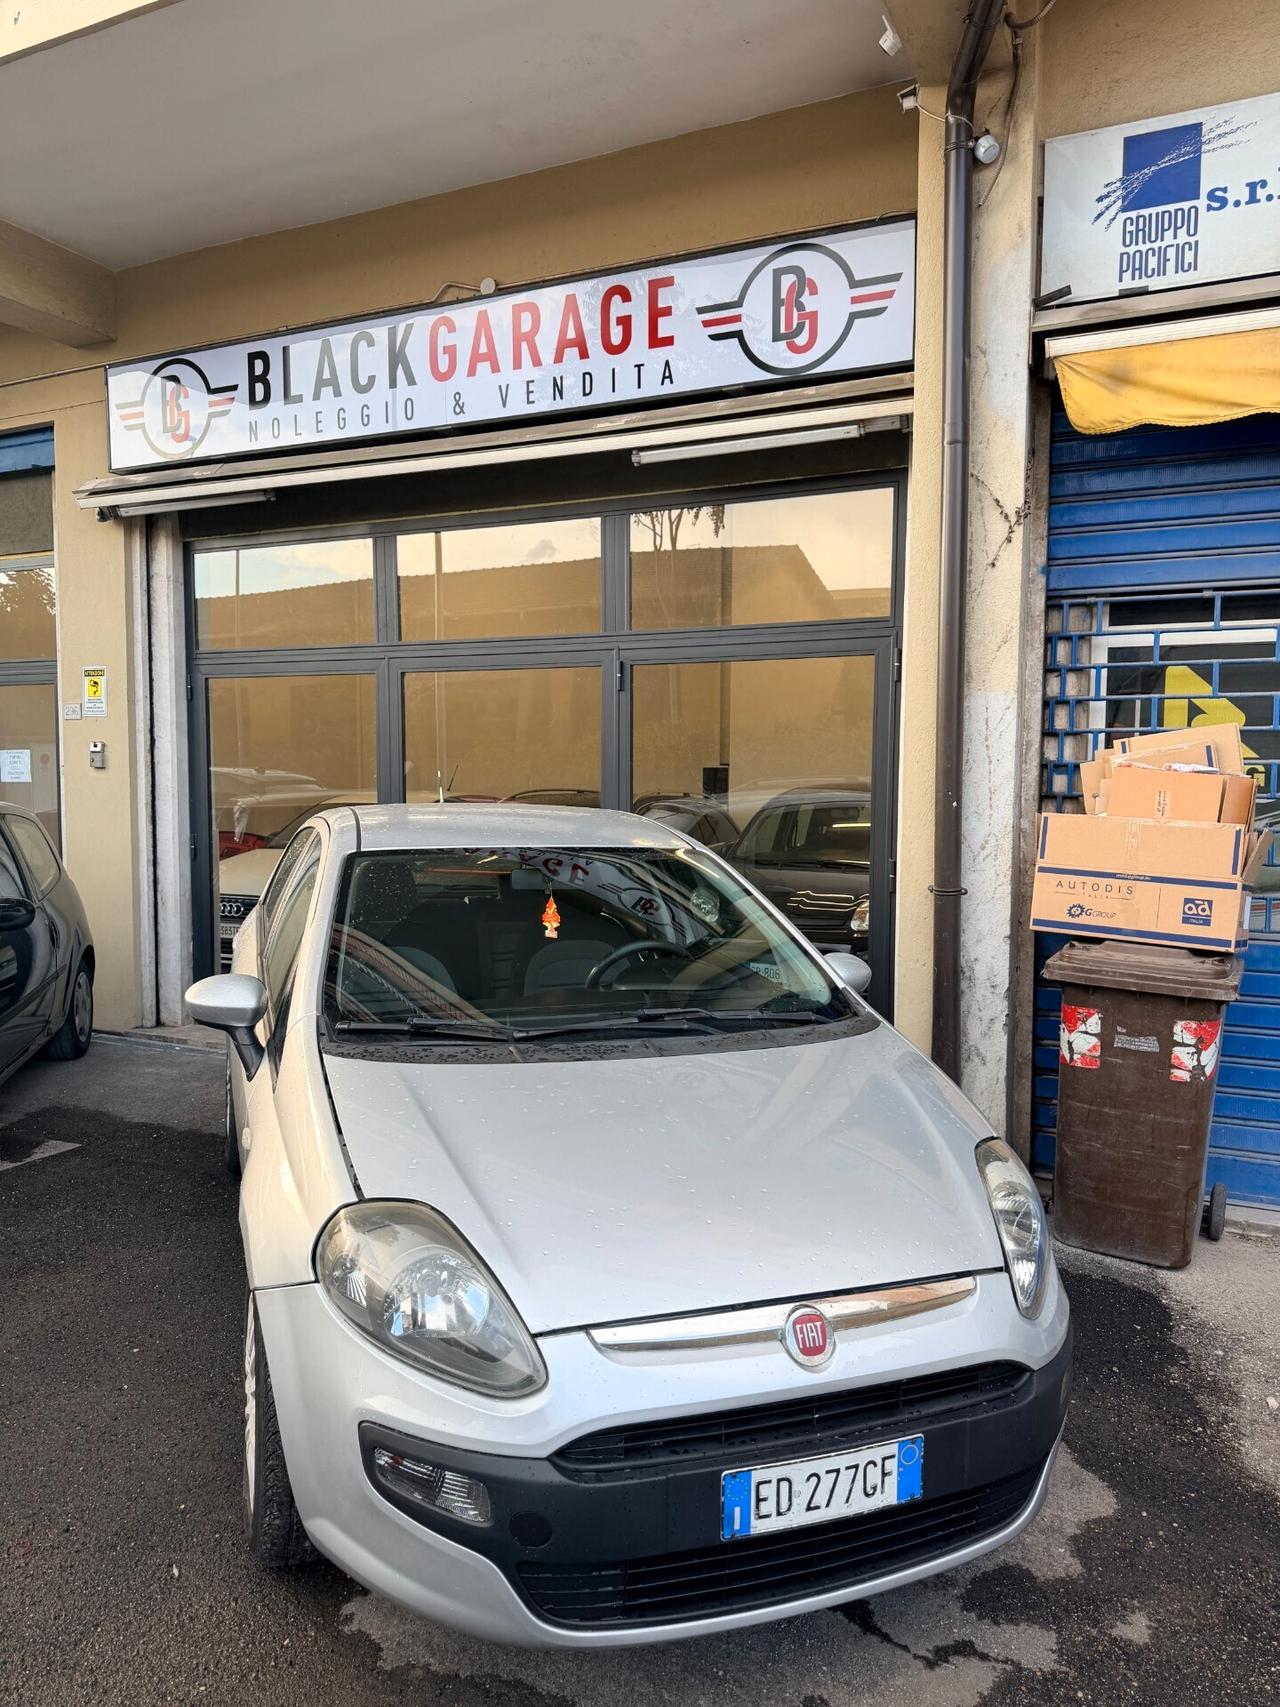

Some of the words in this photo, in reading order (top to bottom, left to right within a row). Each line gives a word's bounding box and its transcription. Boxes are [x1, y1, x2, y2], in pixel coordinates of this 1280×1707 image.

[1122, 205, 1199, 248] GRUPPO
[1118, 240, 1199, 283] PACIFICI
[248, 396, 415, 443] NOLEGGIO
[452, 391, 466, 416] &
[498, 359, 674, 410] VENDITA
[1056, 879, 1134, 895] AUTODIS
[796, 1321, 823, 1349] FIAT
[754, 1477, 793, 1520] ED
[805, 1454, 896, 1512] 277GF
